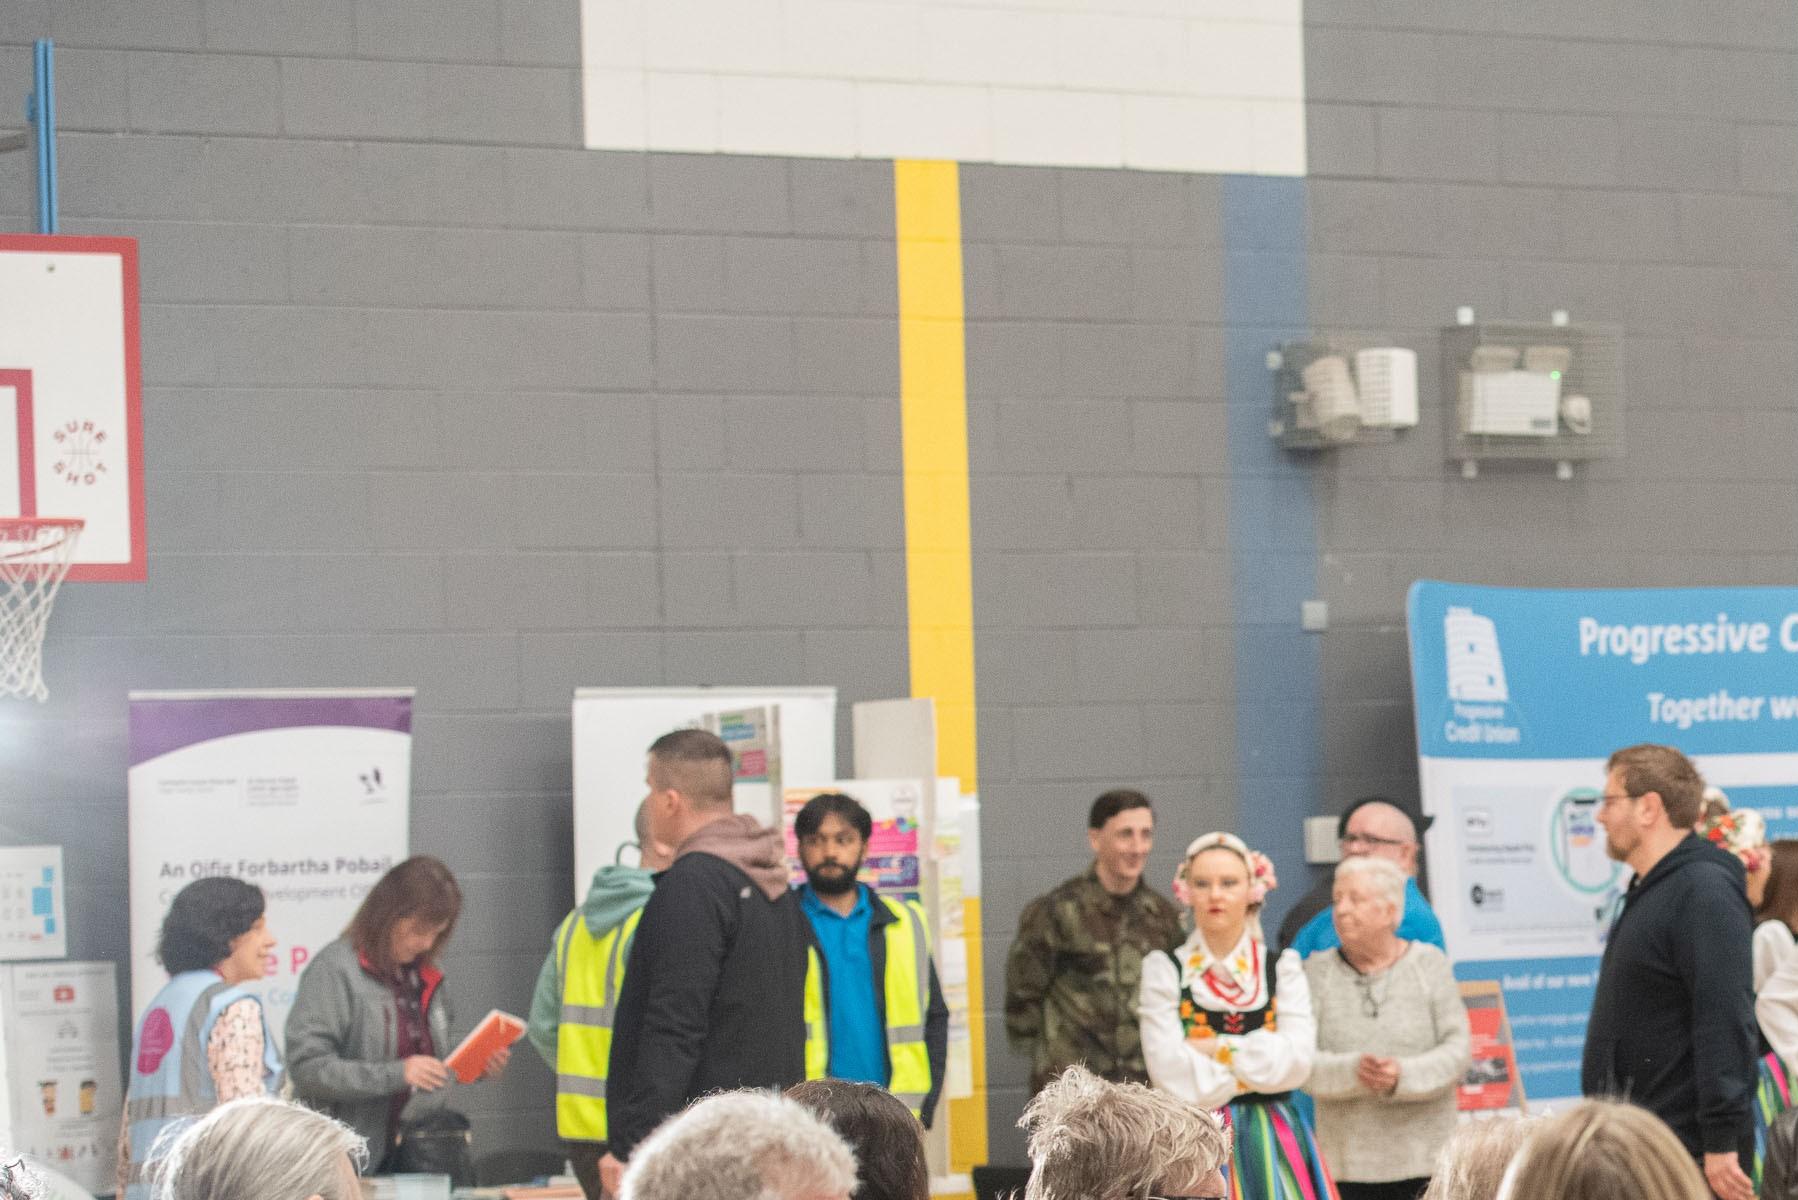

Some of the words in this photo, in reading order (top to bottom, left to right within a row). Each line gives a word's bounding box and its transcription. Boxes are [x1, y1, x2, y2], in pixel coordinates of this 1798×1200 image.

[53, 420, 107, 444] SURE
[53, 461, 107, 485] SHOT
[1579, 612, 1771, 665] Progressive
[1646, 689, 1765, 730] Together
[160, 861, 185, 877] An
[238, 857, 329, 877] Forbartha
